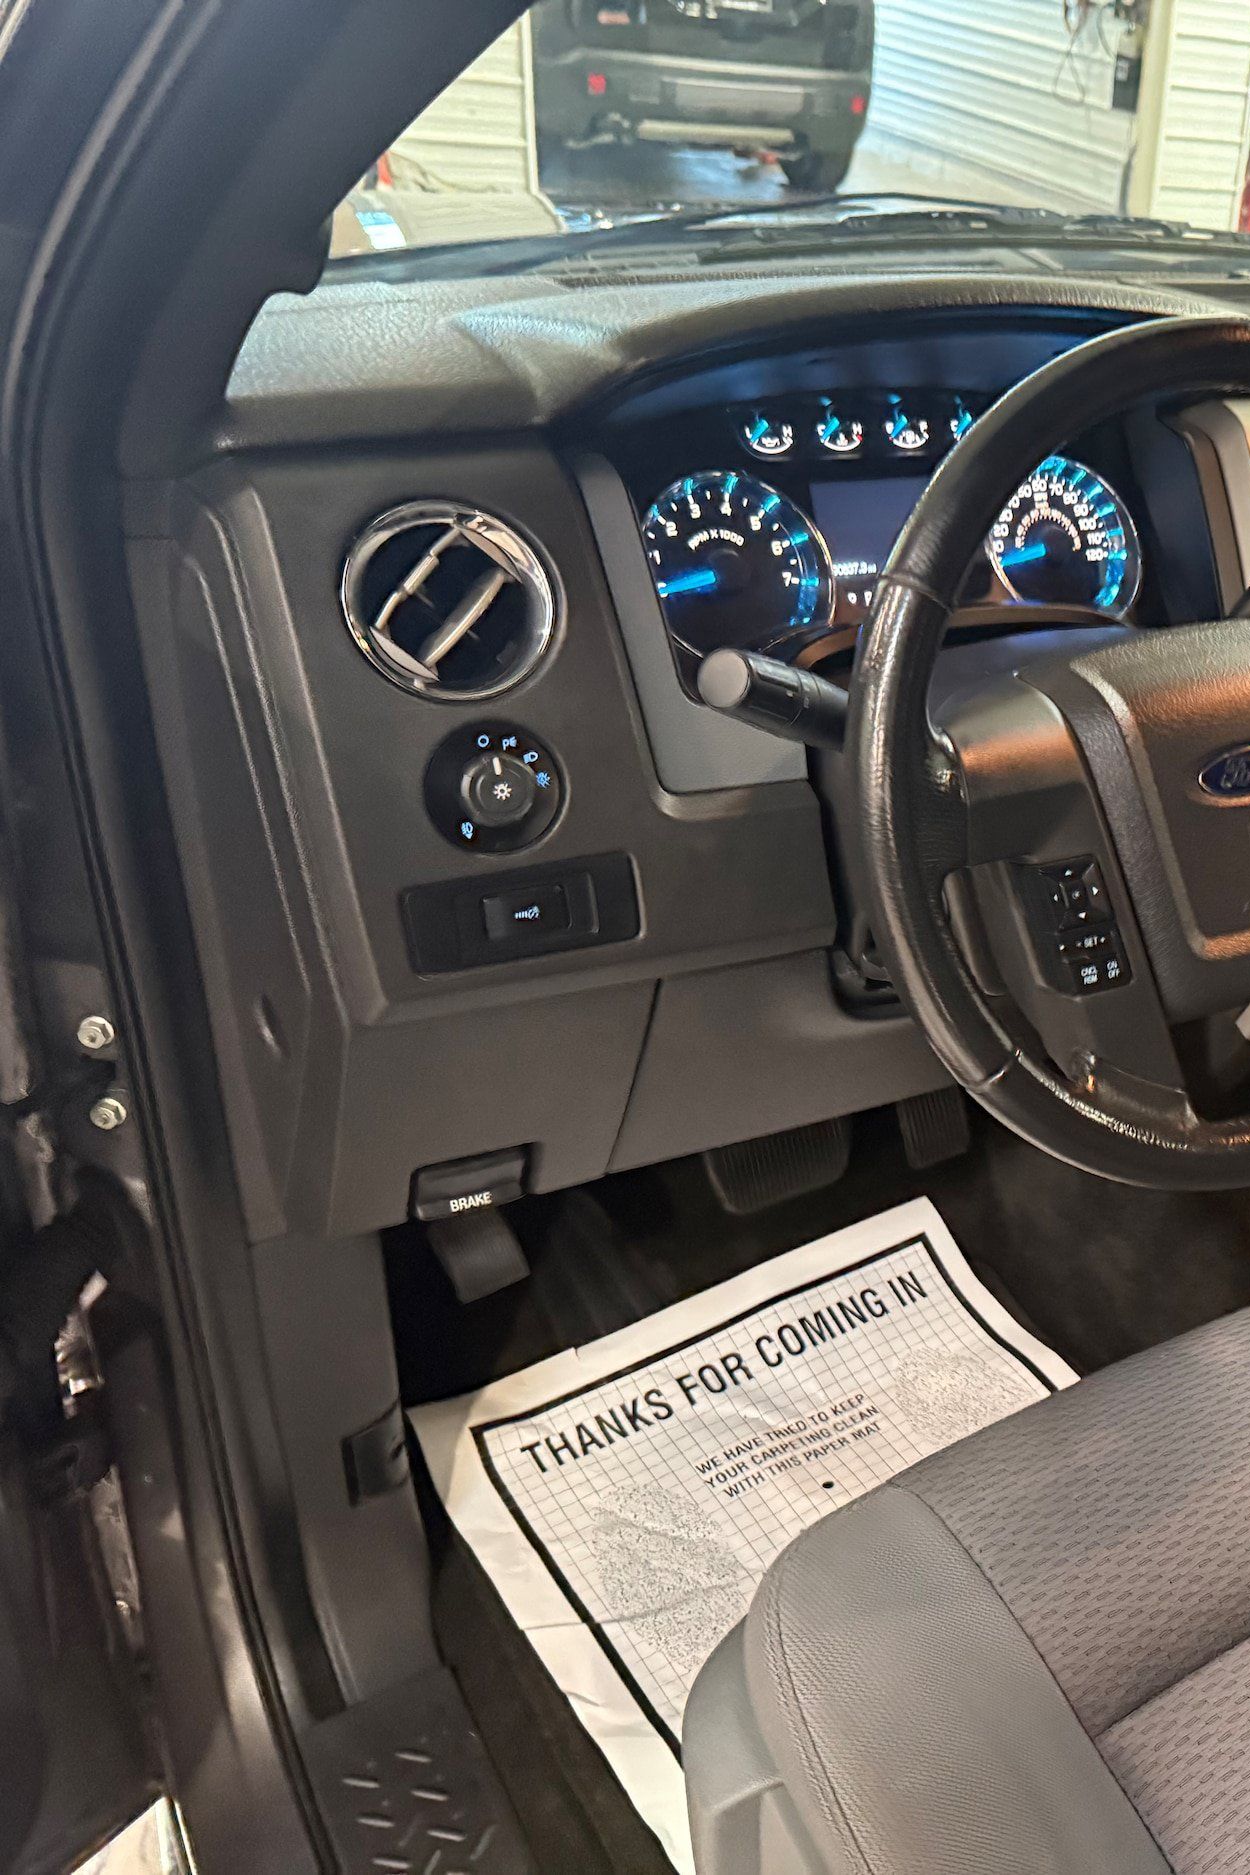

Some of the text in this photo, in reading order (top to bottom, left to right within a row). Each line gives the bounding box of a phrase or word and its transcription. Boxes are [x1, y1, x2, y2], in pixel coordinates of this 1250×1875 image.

[689, 502, 701, 519] 3
[720, 502, 732, 517] 4
[665, 520, 678, 537] 2
[750, 515, 762, 531] 5
[771, 540, 783, 556] 6
[781, 571, 792, 587] 7
[449, 1191, 493, 1213] BRAKE
[520, 1271, 928, 1474] THANKS FOR COMING IN
[695, 1394, 866, 1475] WE HAVE TRIED TO KEEP
[705, 1405, 880, 1489] YOUR CARPETING CLEAN
[723, 1421, 882, 1498] WITH THIS PAPER MAT
